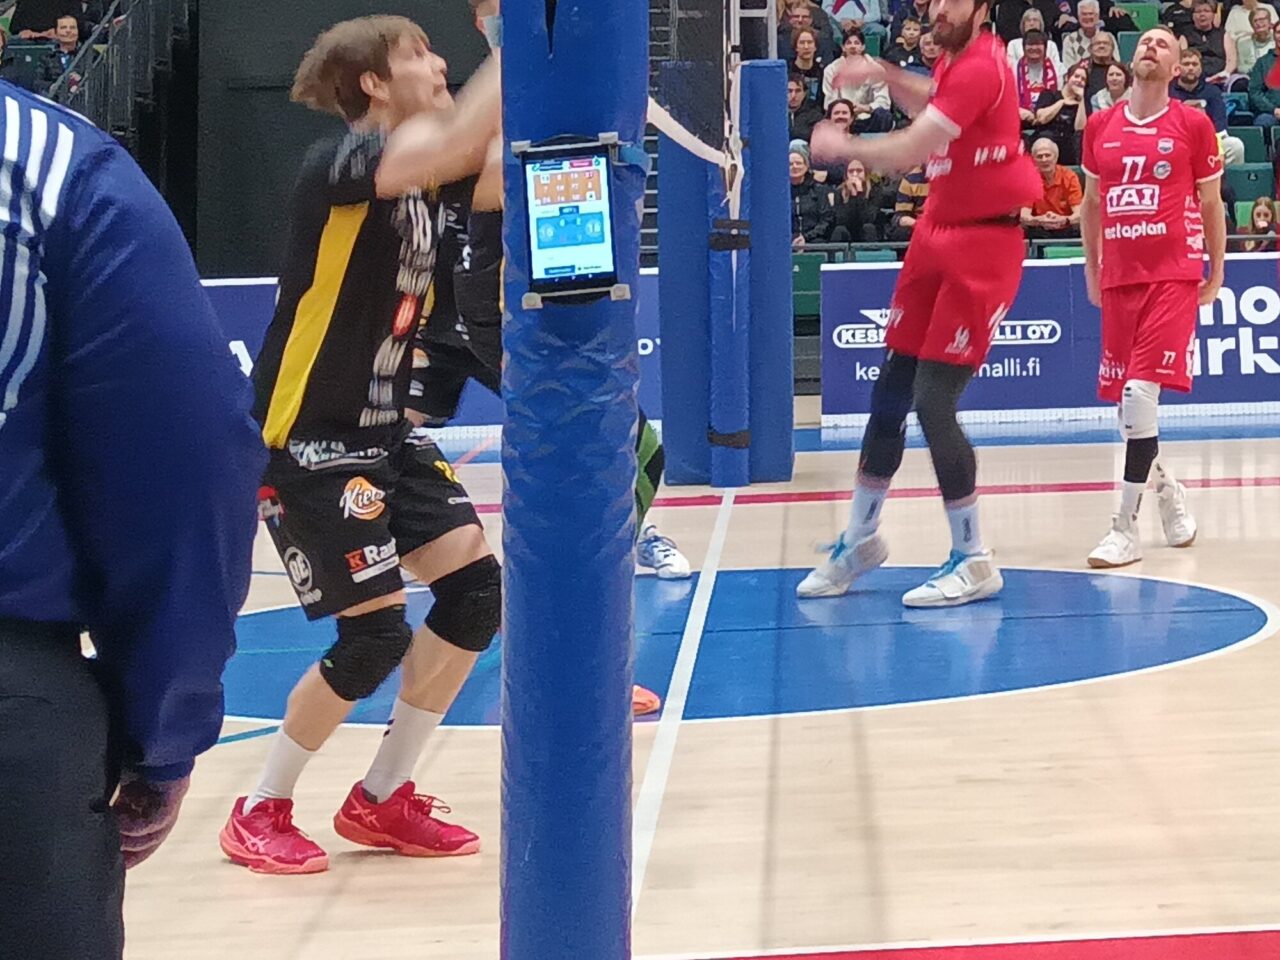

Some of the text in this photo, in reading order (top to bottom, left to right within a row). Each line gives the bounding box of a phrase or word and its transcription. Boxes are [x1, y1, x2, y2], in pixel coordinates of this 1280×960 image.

[1121, 155, 1147, 184] 77
[1108, 188, 1154, 208] TAI
[1026, 325, 1053, 340] OY
